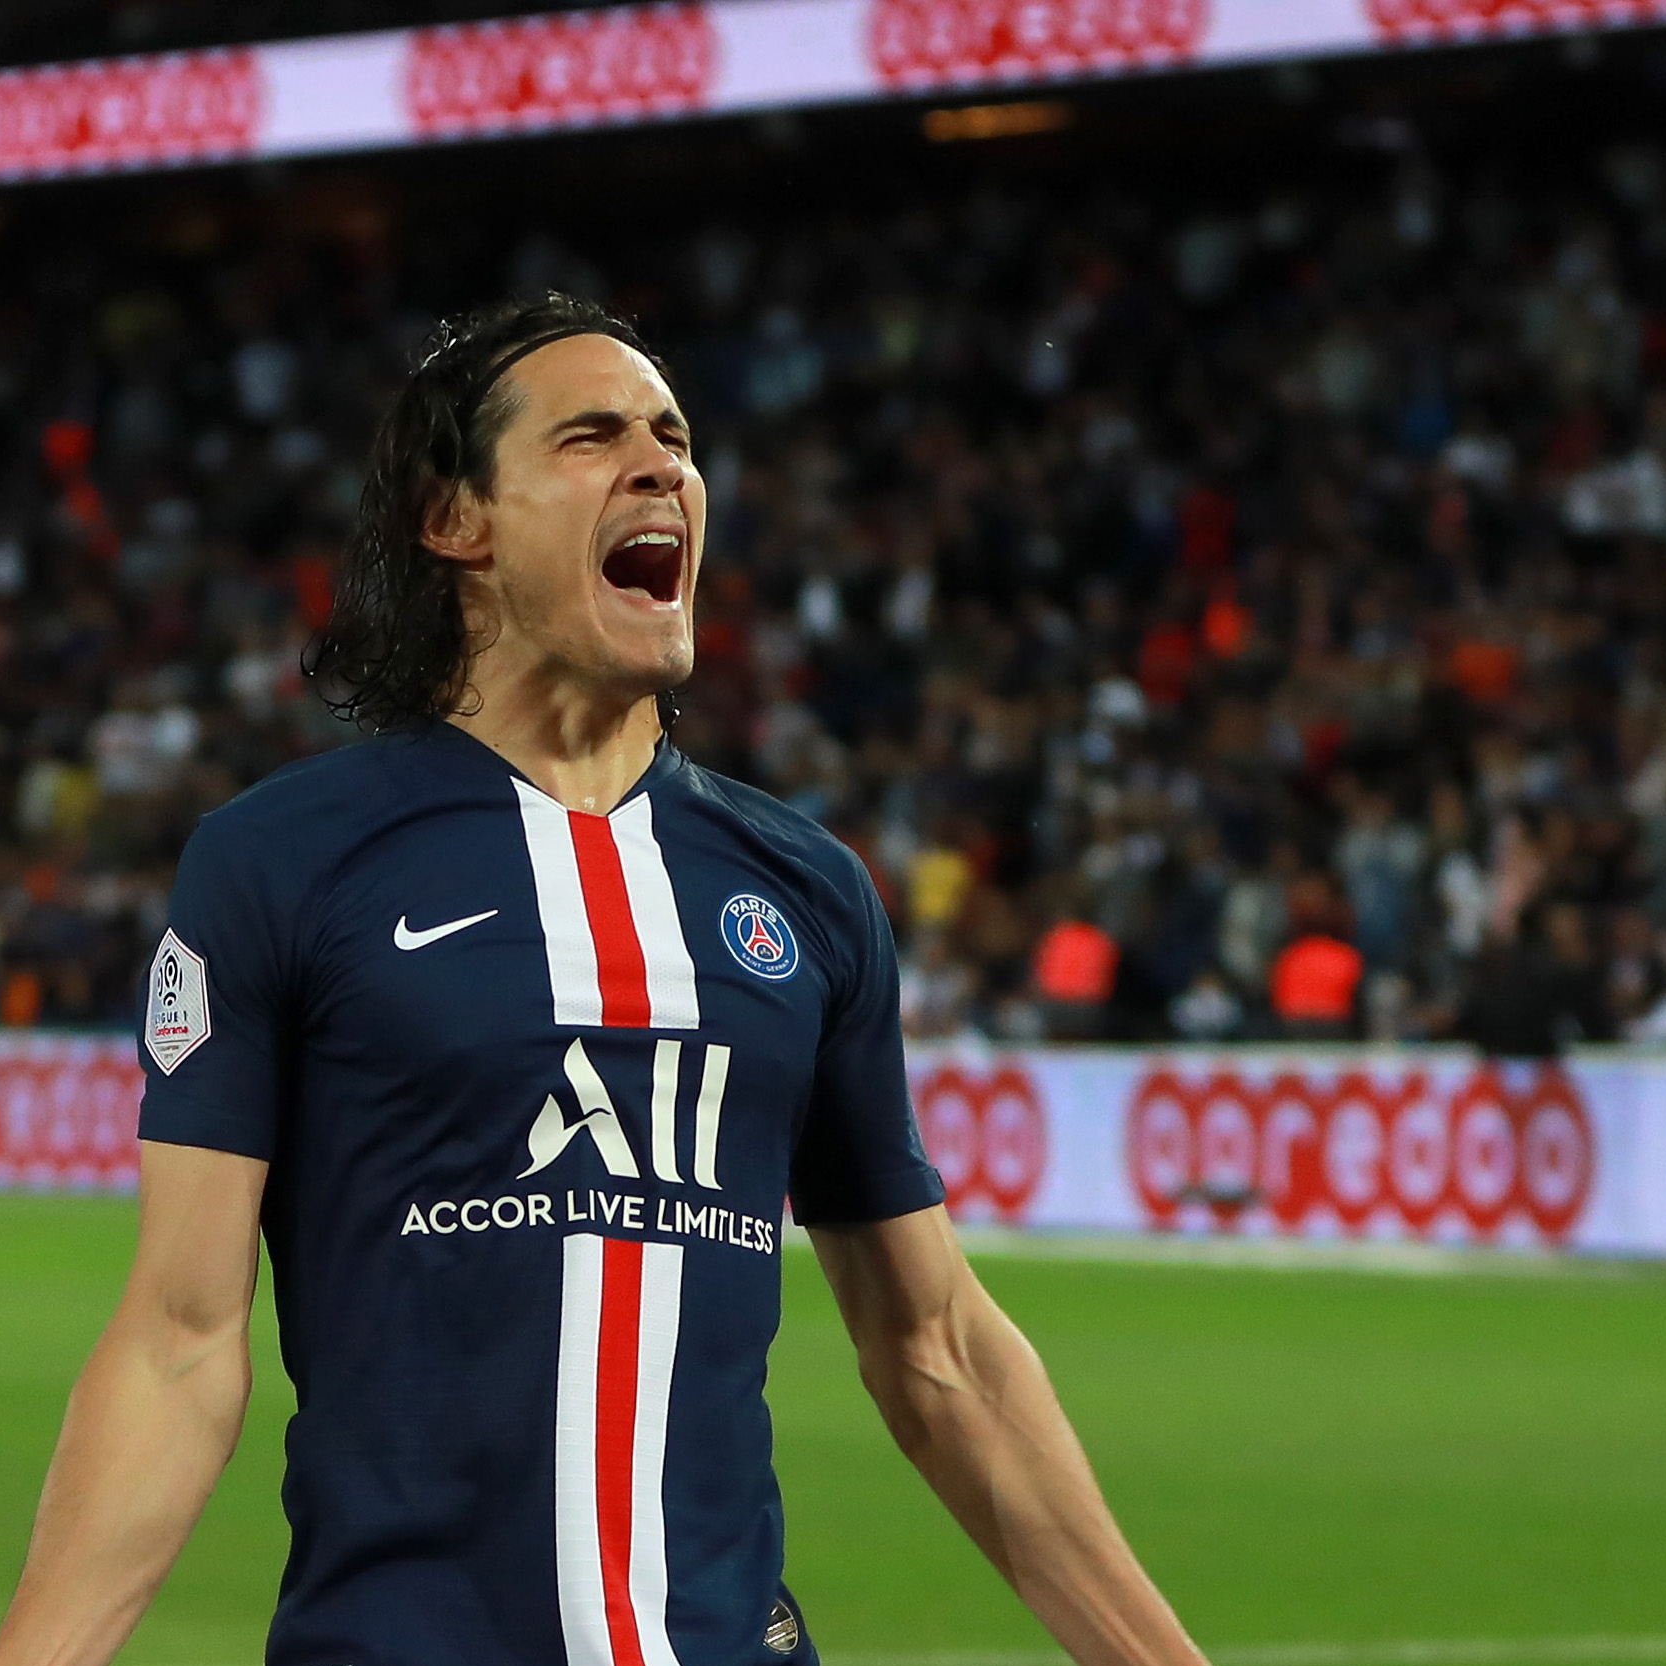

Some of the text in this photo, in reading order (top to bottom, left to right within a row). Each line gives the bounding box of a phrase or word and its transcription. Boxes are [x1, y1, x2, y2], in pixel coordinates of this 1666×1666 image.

[729, 899, 778, 923] PARIS
[1137, 1072, 1579, 1212] ooredoo
[400, 1189, 774, 1255] ACCOR LIVE LIMITLESS
